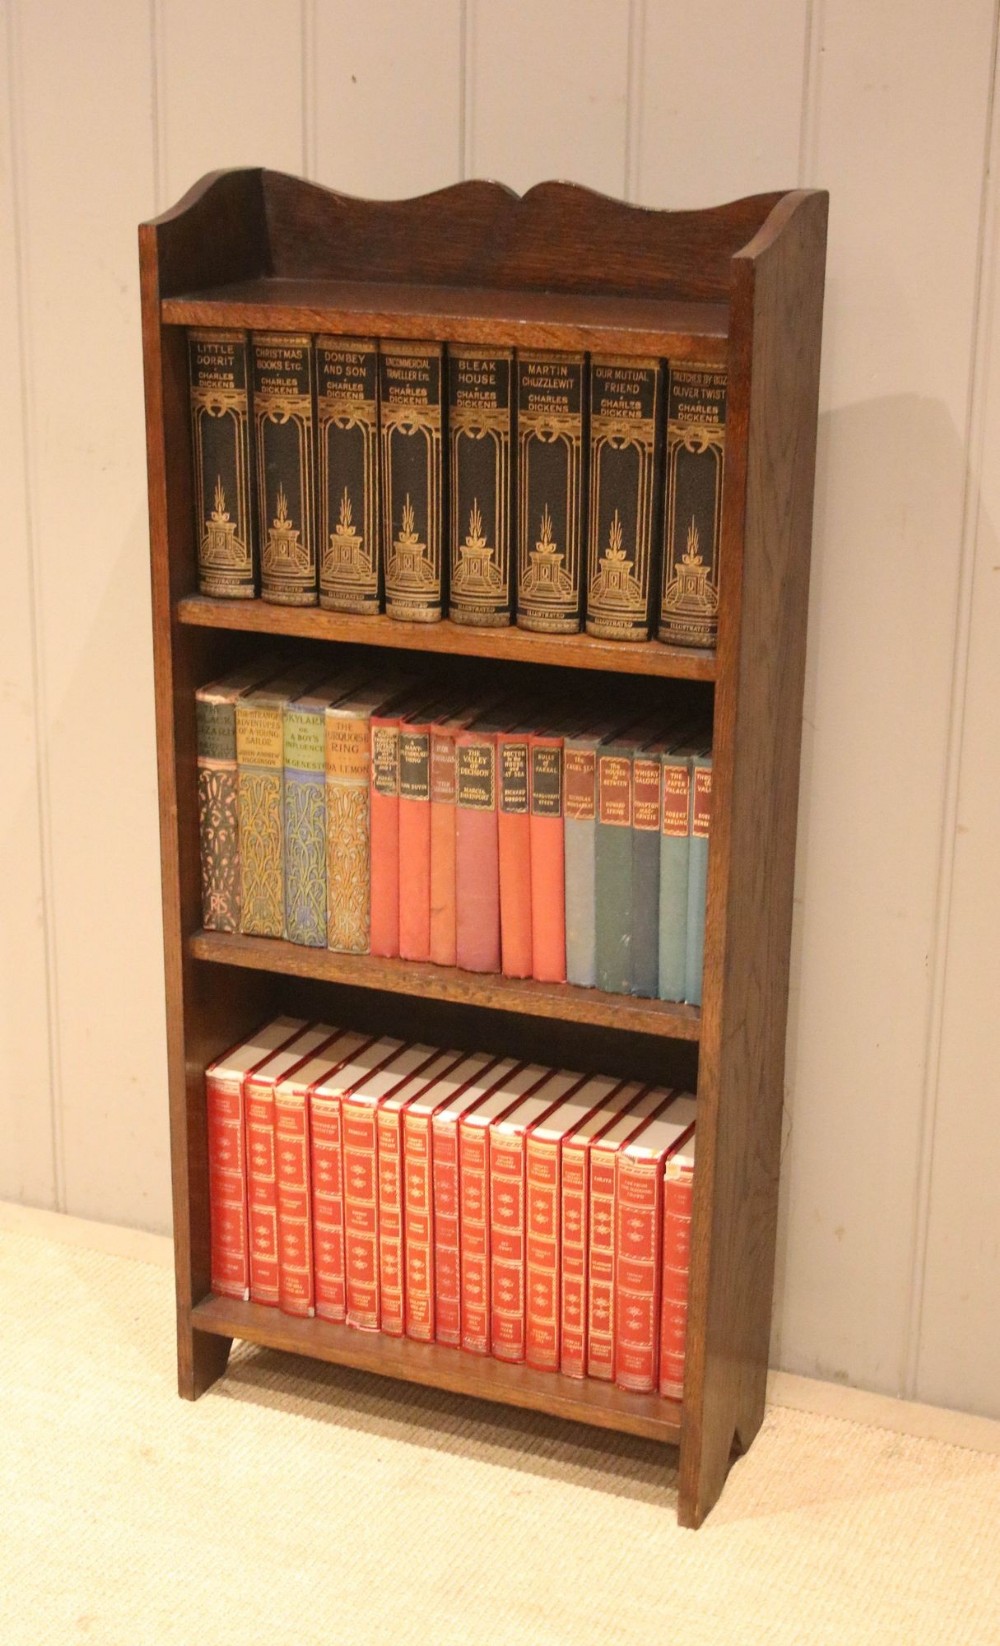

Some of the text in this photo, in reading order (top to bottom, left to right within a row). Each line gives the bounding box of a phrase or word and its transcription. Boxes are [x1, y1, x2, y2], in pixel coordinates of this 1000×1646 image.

[197, 344, 234, 354] LITTLE
[256, 348, 302, 359] CHRISTMAS
[197, 356, 234, 366] DORRIT
[324, 351, 366, 363] DOMBEY
[257, 360, 282, 370] BOOKS
[386, 357, 430, 369] UNCOMMERCIAL
[458, 361, 496, 372] BLEAK
[324, 365, 366, 377] AND SON
[528, 365, 567, 376] MARTIN
[596, 368, 648, 381] OUR MUTUAL
[199, 371, 234, 381] CHARLES
[458, 374, 496, 384] HOUSE
[199, 380, 235, 388] DICKENS
[261, 377, 298, 386] CHARLES
[326, 381, 363, 391] CHARLES
[522, 377, 574, 389] CHUZZLEWIT
[261, 386, 299, 395] DICKENS
[389, 386, 428, 396] CHARLES
[604, 382, 640, 394] FRIEND
[673, 386, 726, 400] OLIVER TWIST
[327, 390, 364, 400] DICKENS
[389, 395, 428, 405] DICKENS
[456, 390, 496, 400] CHARLES
[528, 394, 568, 404] CHARLES
[457, 400, 497, 409] DICKENS
[528, 403, 569, 413] DICKENS
[601, 399, 641, 410] CHARLES
[678, 403, 719, 414] CHARLES
[601, 409, 642, 418] DICKENS
[678, 413, 719, 423] DICKENS
[458, 605, 495, 613] ILLUSTRATED
[336, 722, 352, 730] THE
[245, 737, 272, 745] SAILOR
[327, 731, 369, 743] URQUOISE
[331, 742, 359, 754] RING
[463, 755, 487, 764] VALLEY
[460, 767, 489, 776] DECISION
[583, 765, 594, 773] SEA
[635, 769, 658, 777] WHISKY
[603, 779, 627, 787] BETWEEN
[635, 777, 659, 785] GALORE
[666, 787, 687, 795] PALACE
